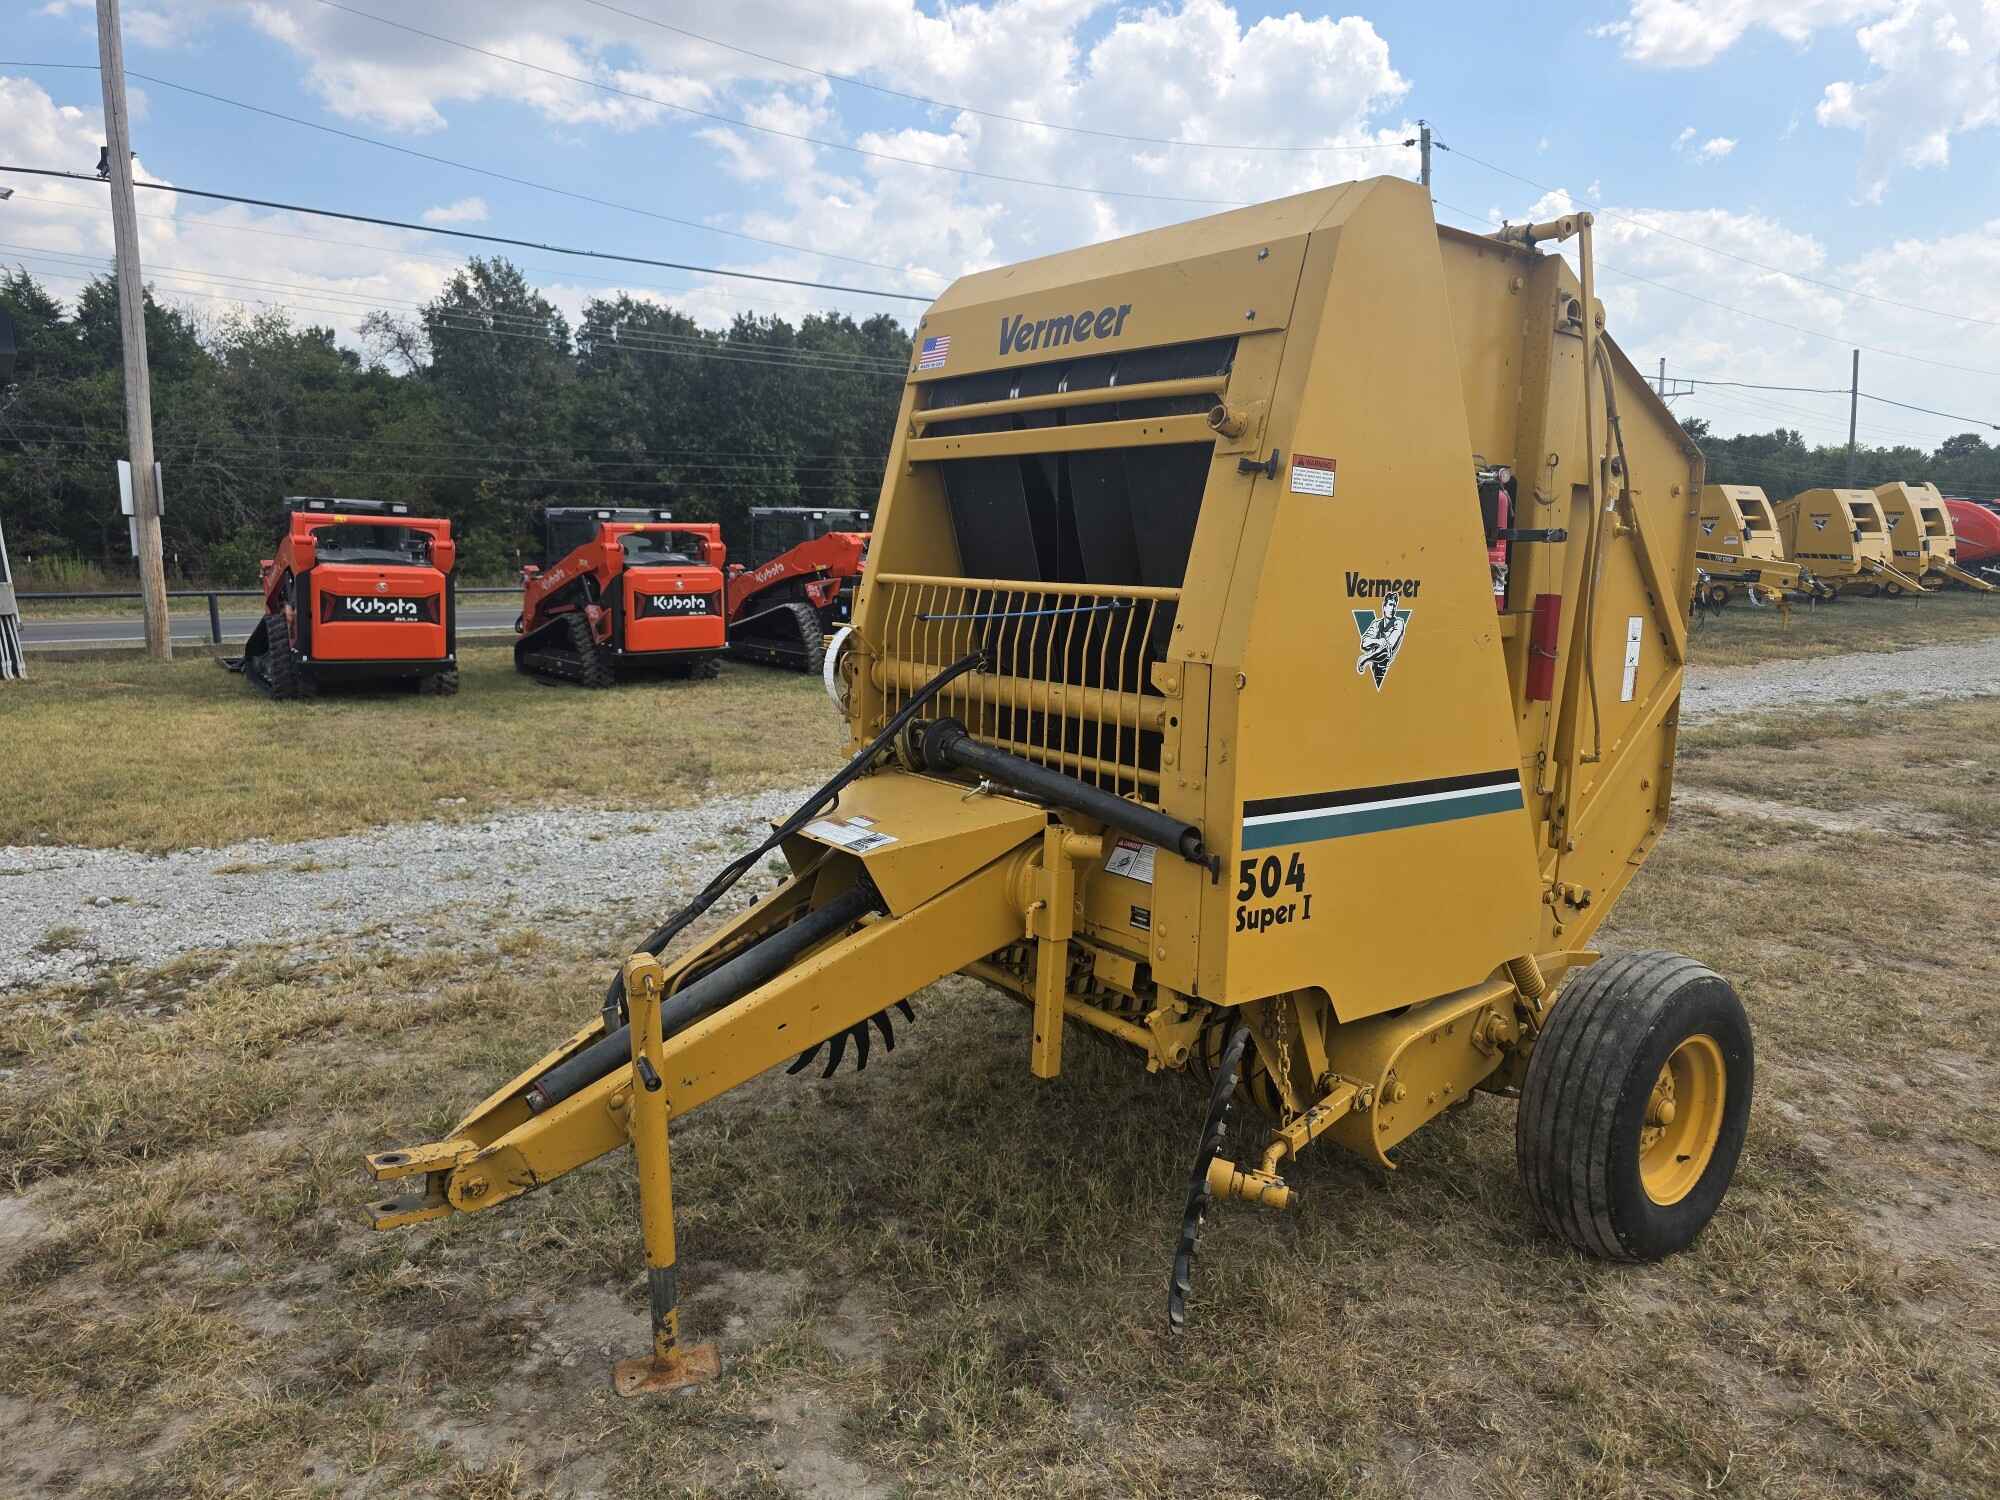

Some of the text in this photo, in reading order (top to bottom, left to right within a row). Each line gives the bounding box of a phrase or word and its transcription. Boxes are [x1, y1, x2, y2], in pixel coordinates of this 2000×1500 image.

[999, 304, 1132, 355] Vermeer
[755, 563, 785, 584] Kubota
[1345, 571, 1421, 598] Vermeer
[346, 597, 417, 614] Kubota
[653, 595, 706, 610] Kubota
[1236, 852, 1306, 902] 504
[1235, 894, 1312, 934] Super I
